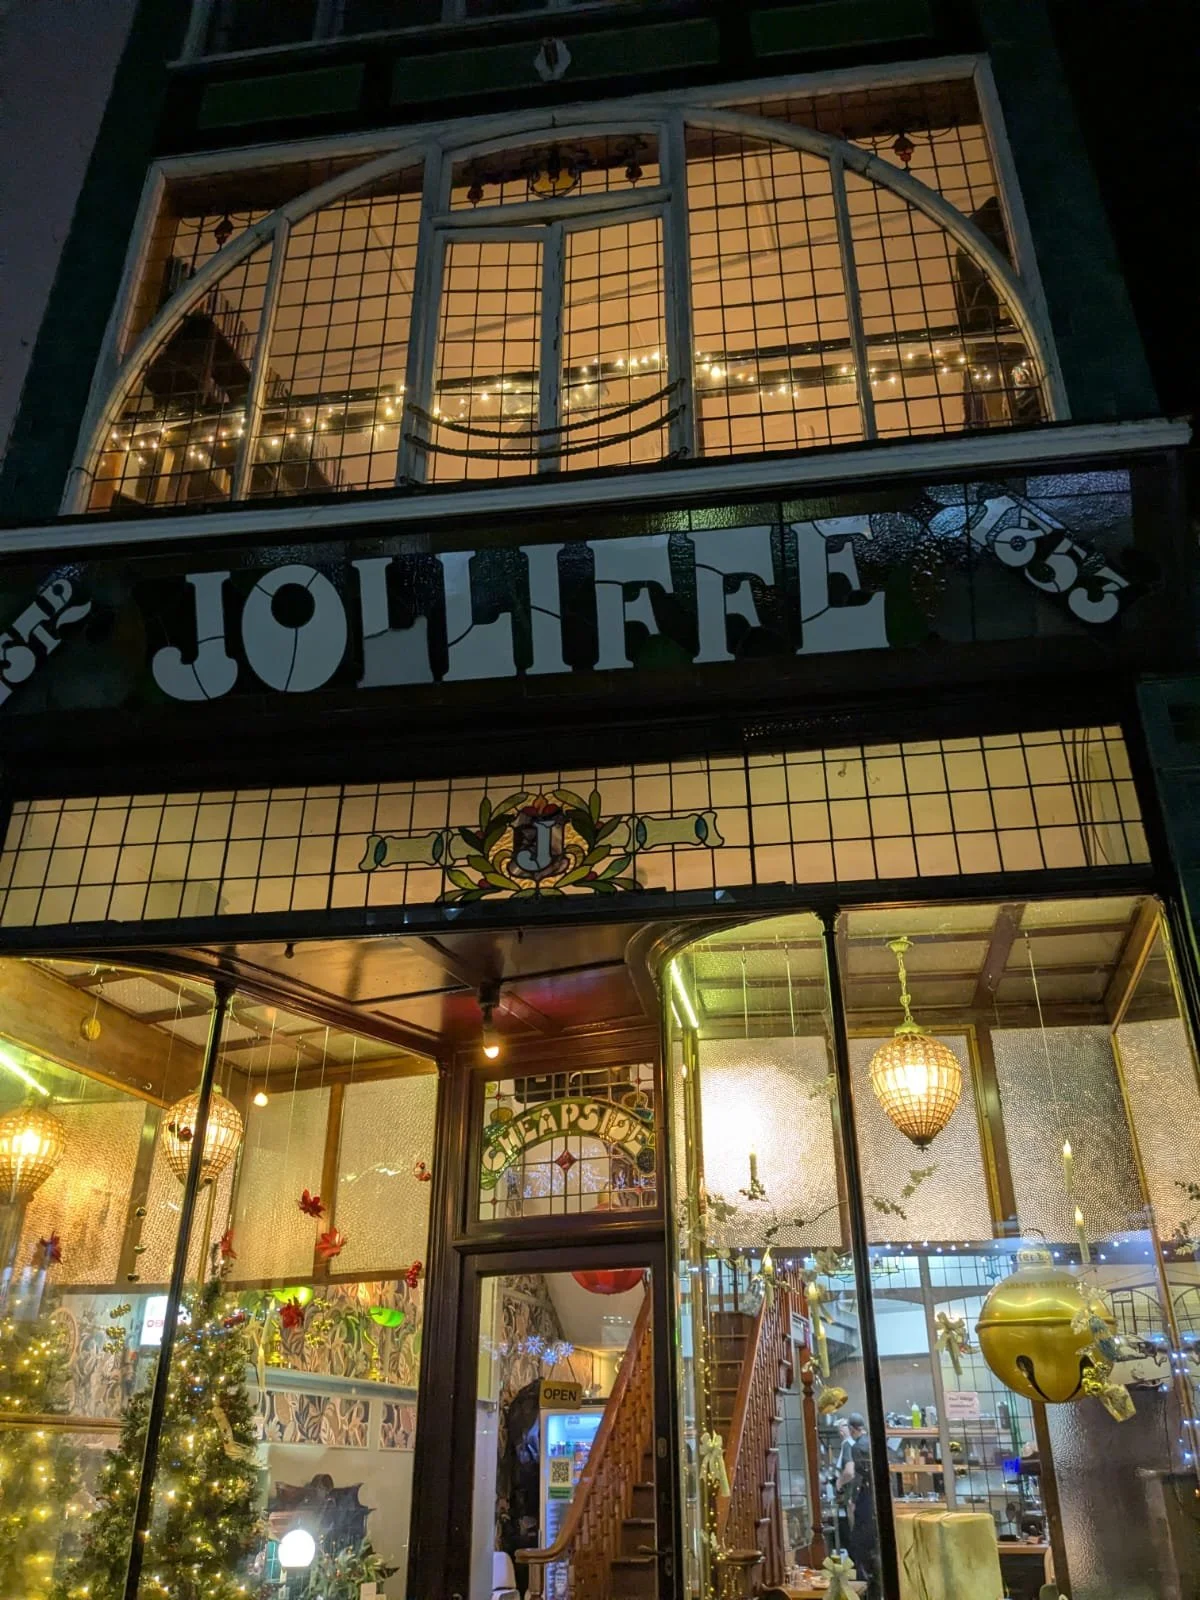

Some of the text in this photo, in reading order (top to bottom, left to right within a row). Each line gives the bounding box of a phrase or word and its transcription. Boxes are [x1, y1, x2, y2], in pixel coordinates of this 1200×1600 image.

[152, 514, 889, 702] JOLLIFFE
[516, 820, 555, 872] J
[482, 1103, 649, 1172] CHEAPSIDE
[543, 1387, 578, 1402] OPEN
